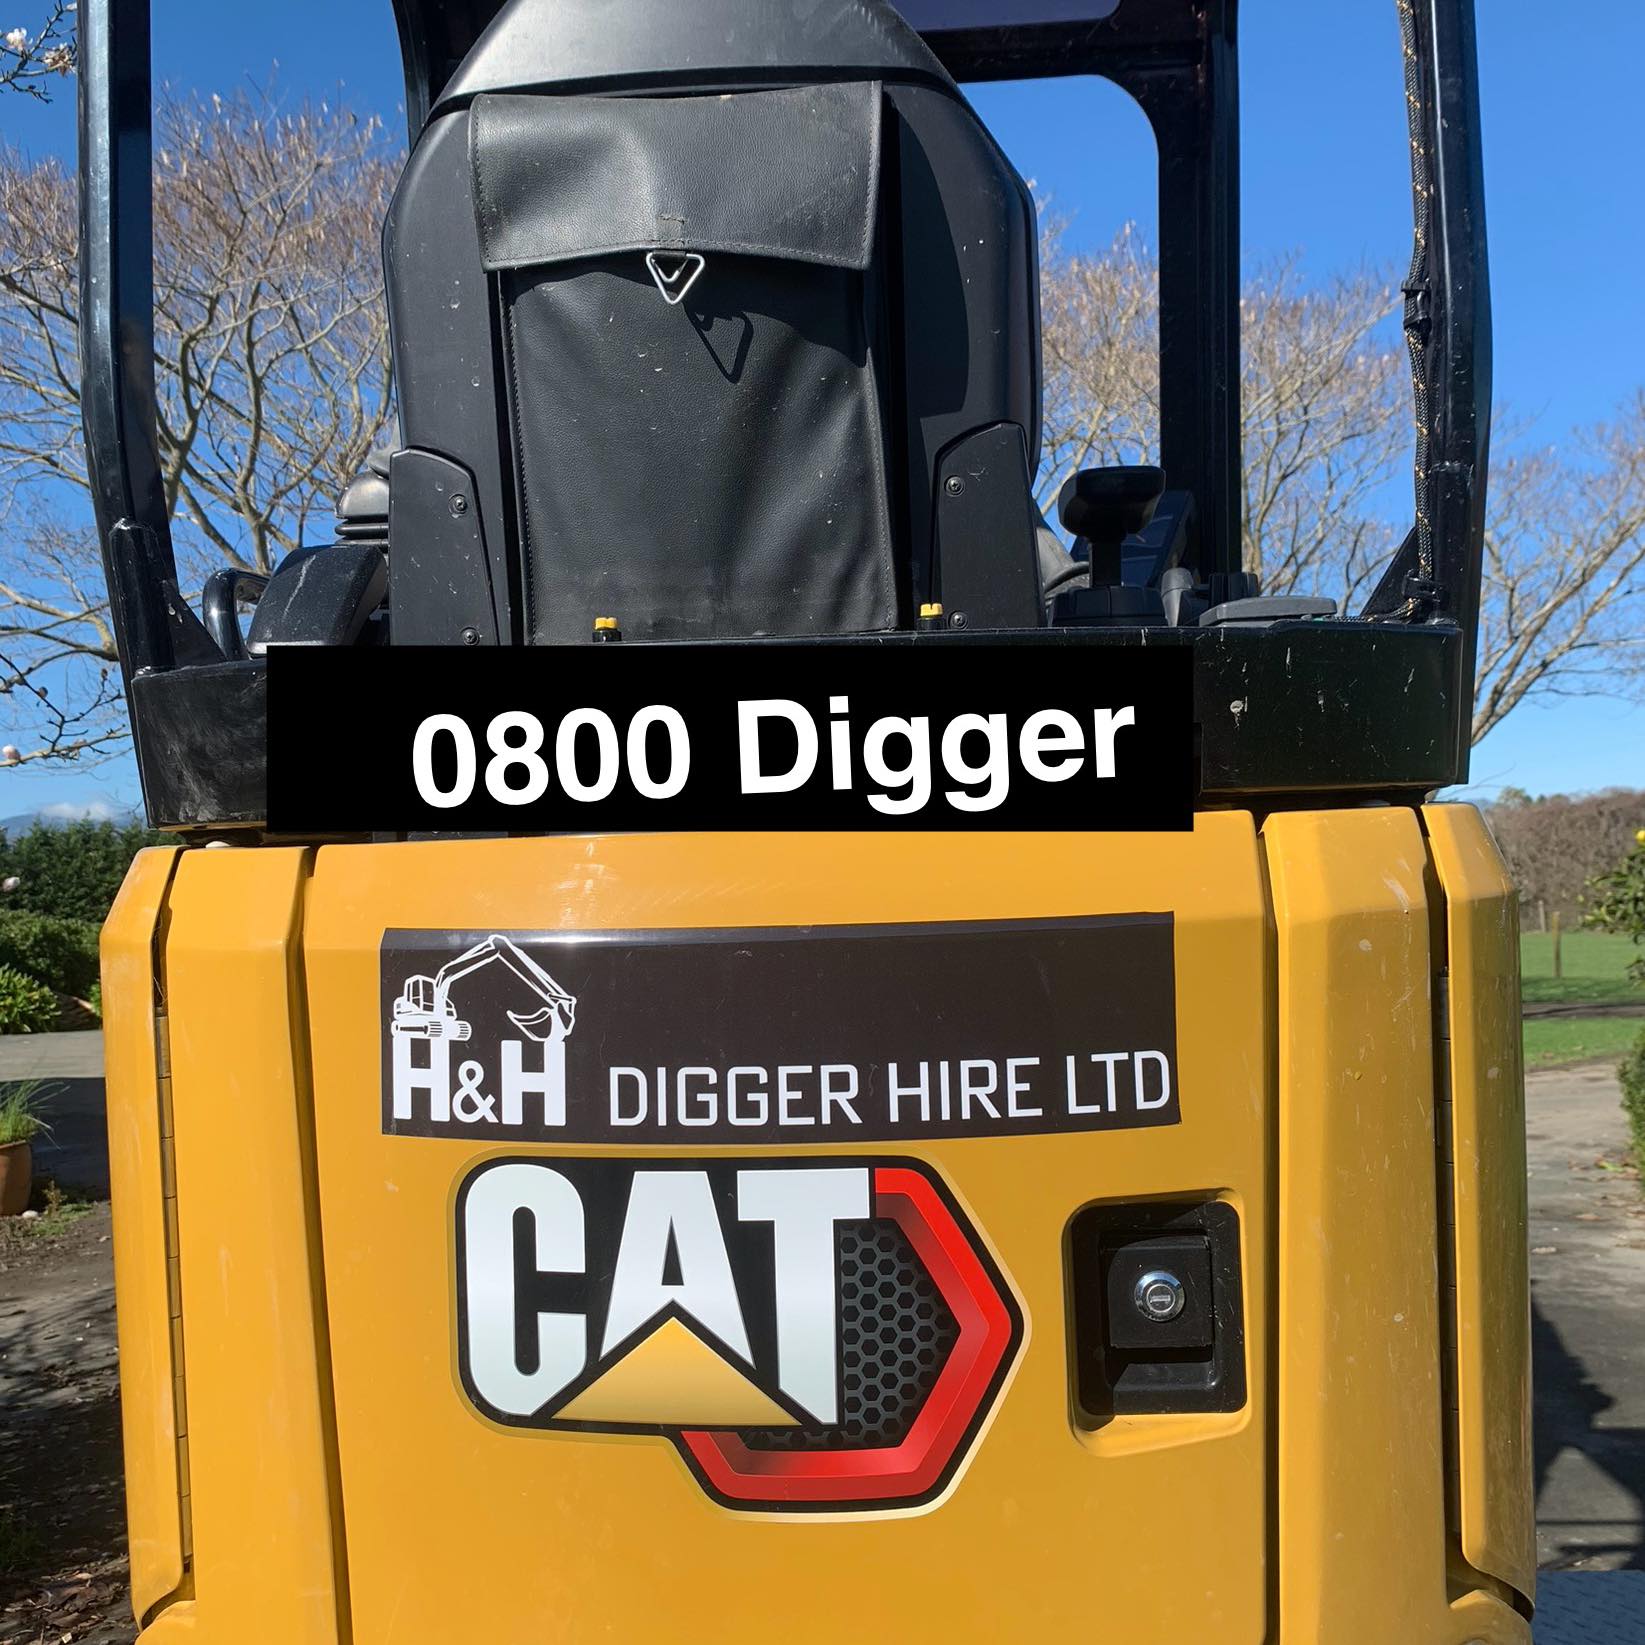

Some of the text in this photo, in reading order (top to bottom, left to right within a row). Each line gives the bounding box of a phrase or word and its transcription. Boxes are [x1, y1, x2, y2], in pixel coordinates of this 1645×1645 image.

[392, 1036, 1170, 1127] H&H DIGGER HIRE LTD
[465, 1163, 870, 1424] CAT
